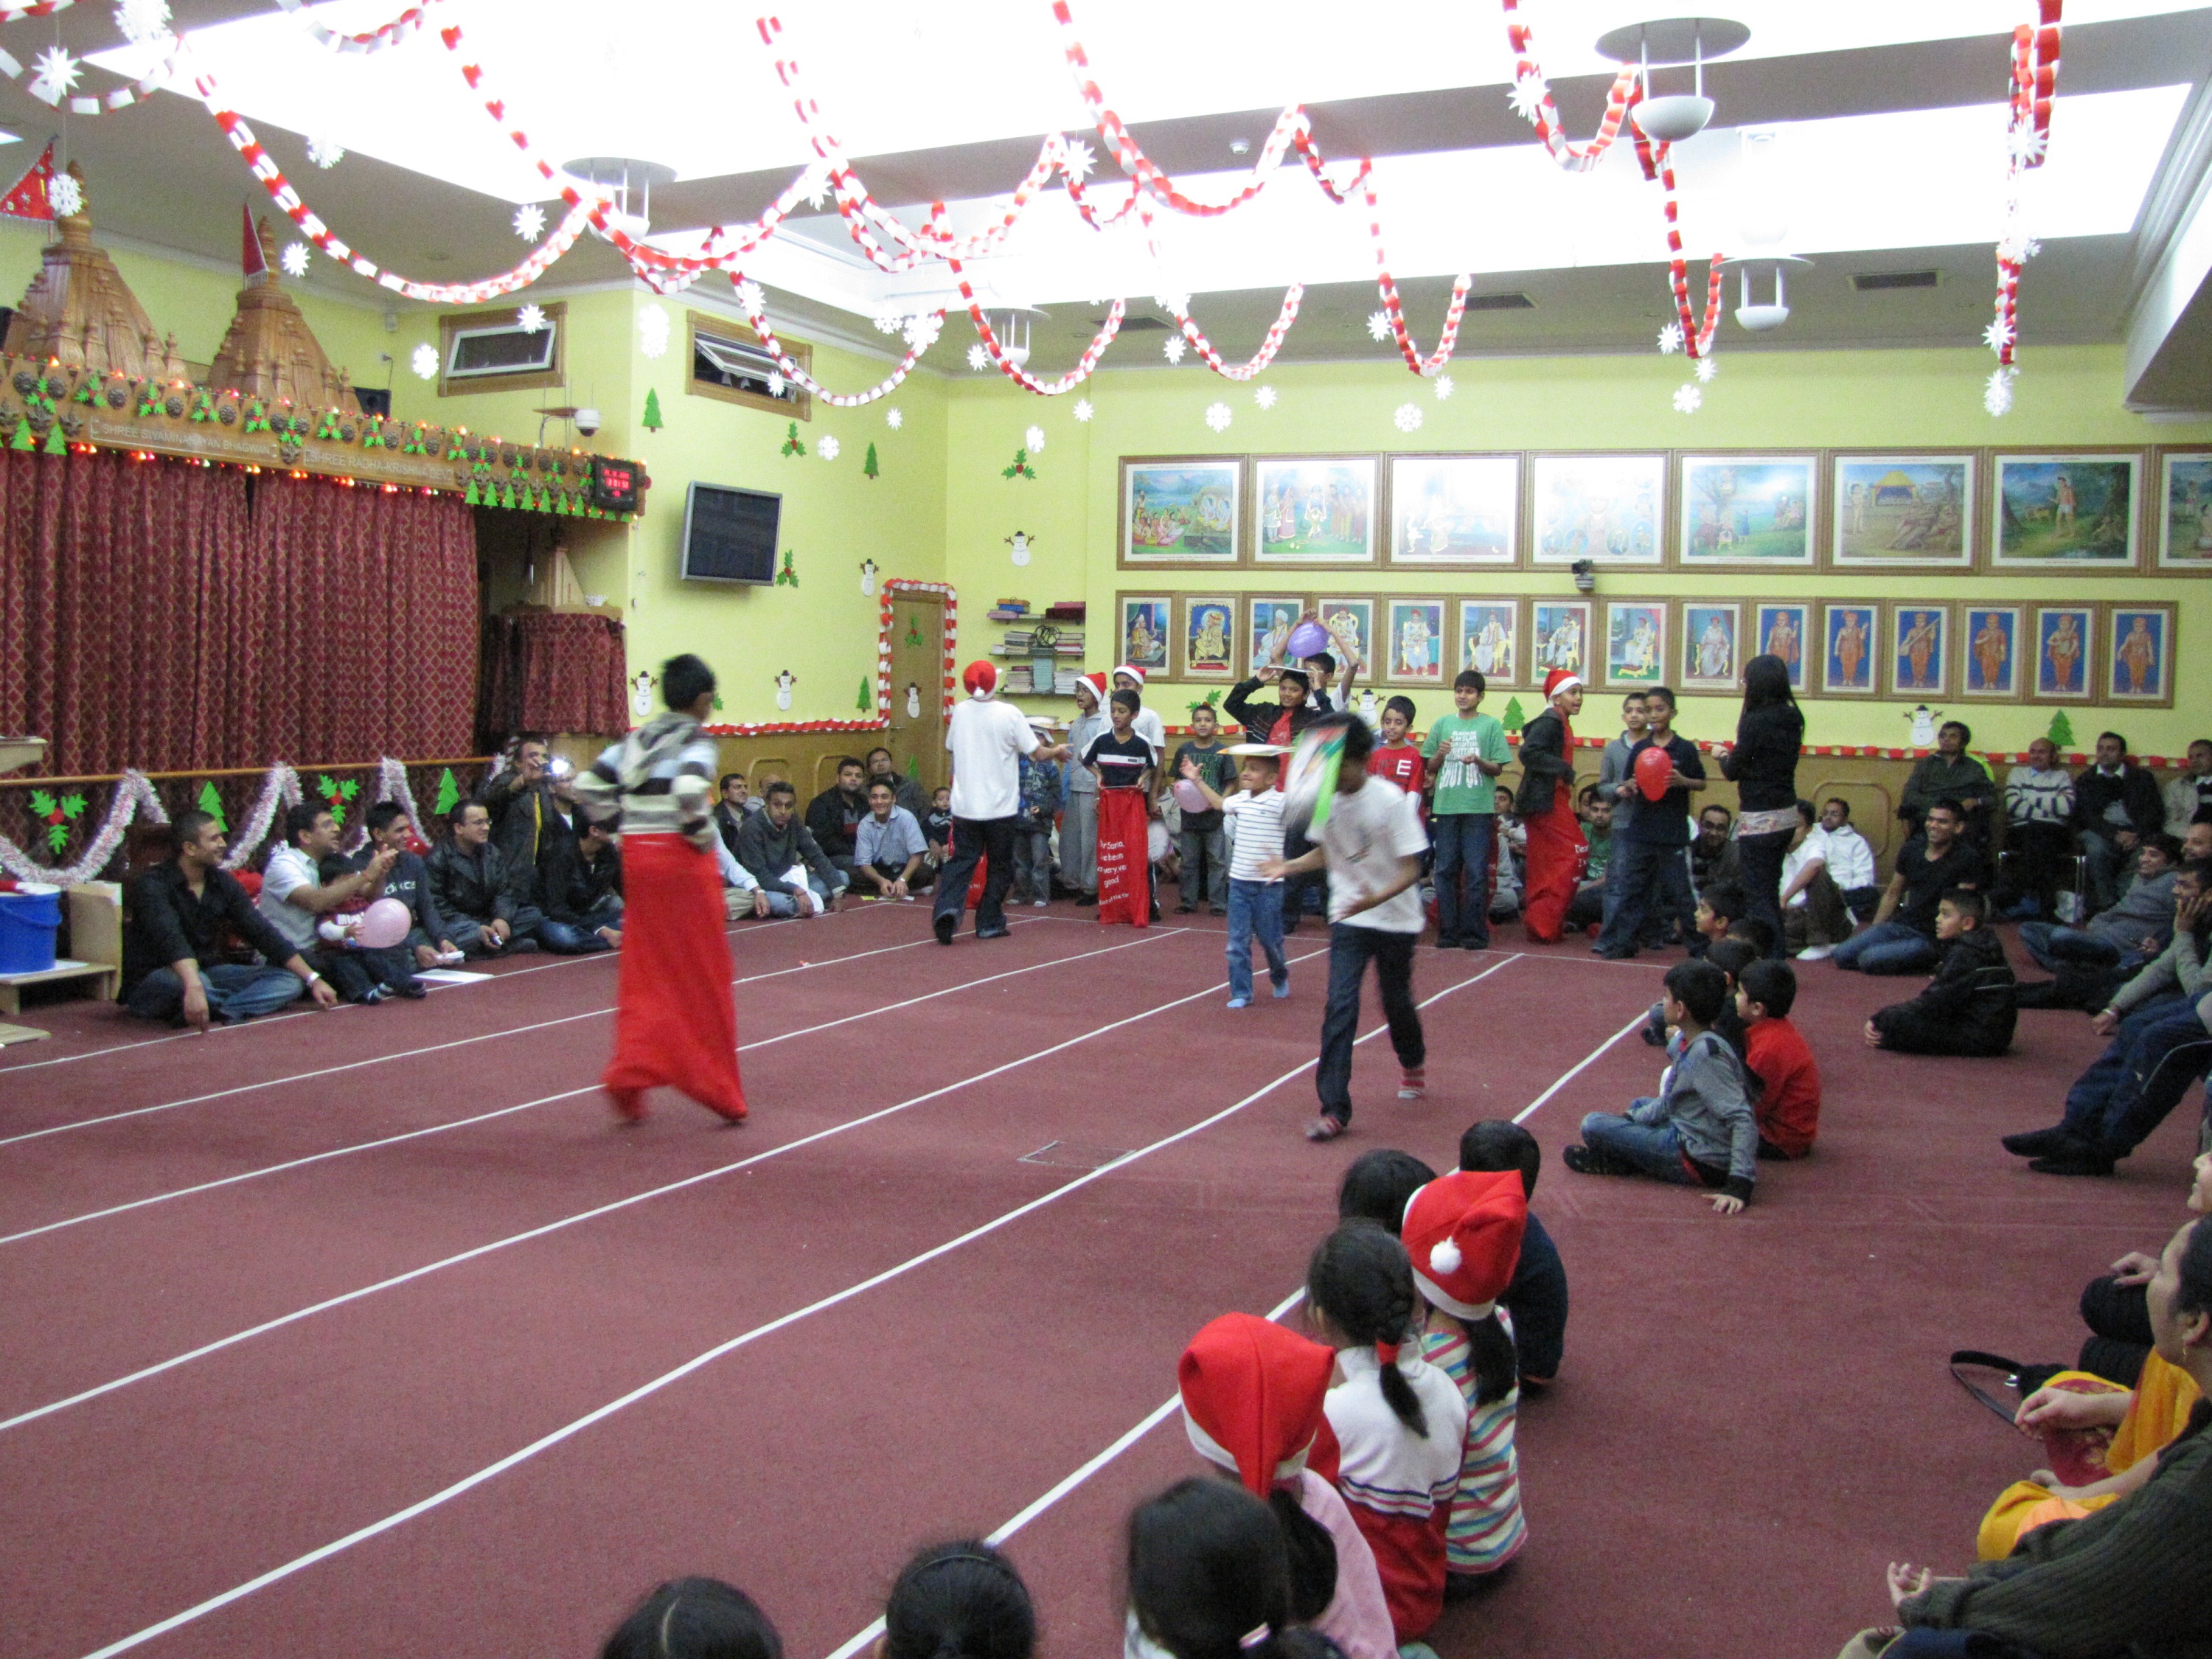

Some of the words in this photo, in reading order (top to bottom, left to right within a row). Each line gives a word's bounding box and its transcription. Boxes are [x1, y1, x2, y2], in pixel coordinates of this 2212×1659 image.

[102, 423, 139, 438] SHREE
[223, 439, 270, 454] BHAGWAN
[310, 451, 347, 467] SHREE
[1104, 875, 1119, 888] good
